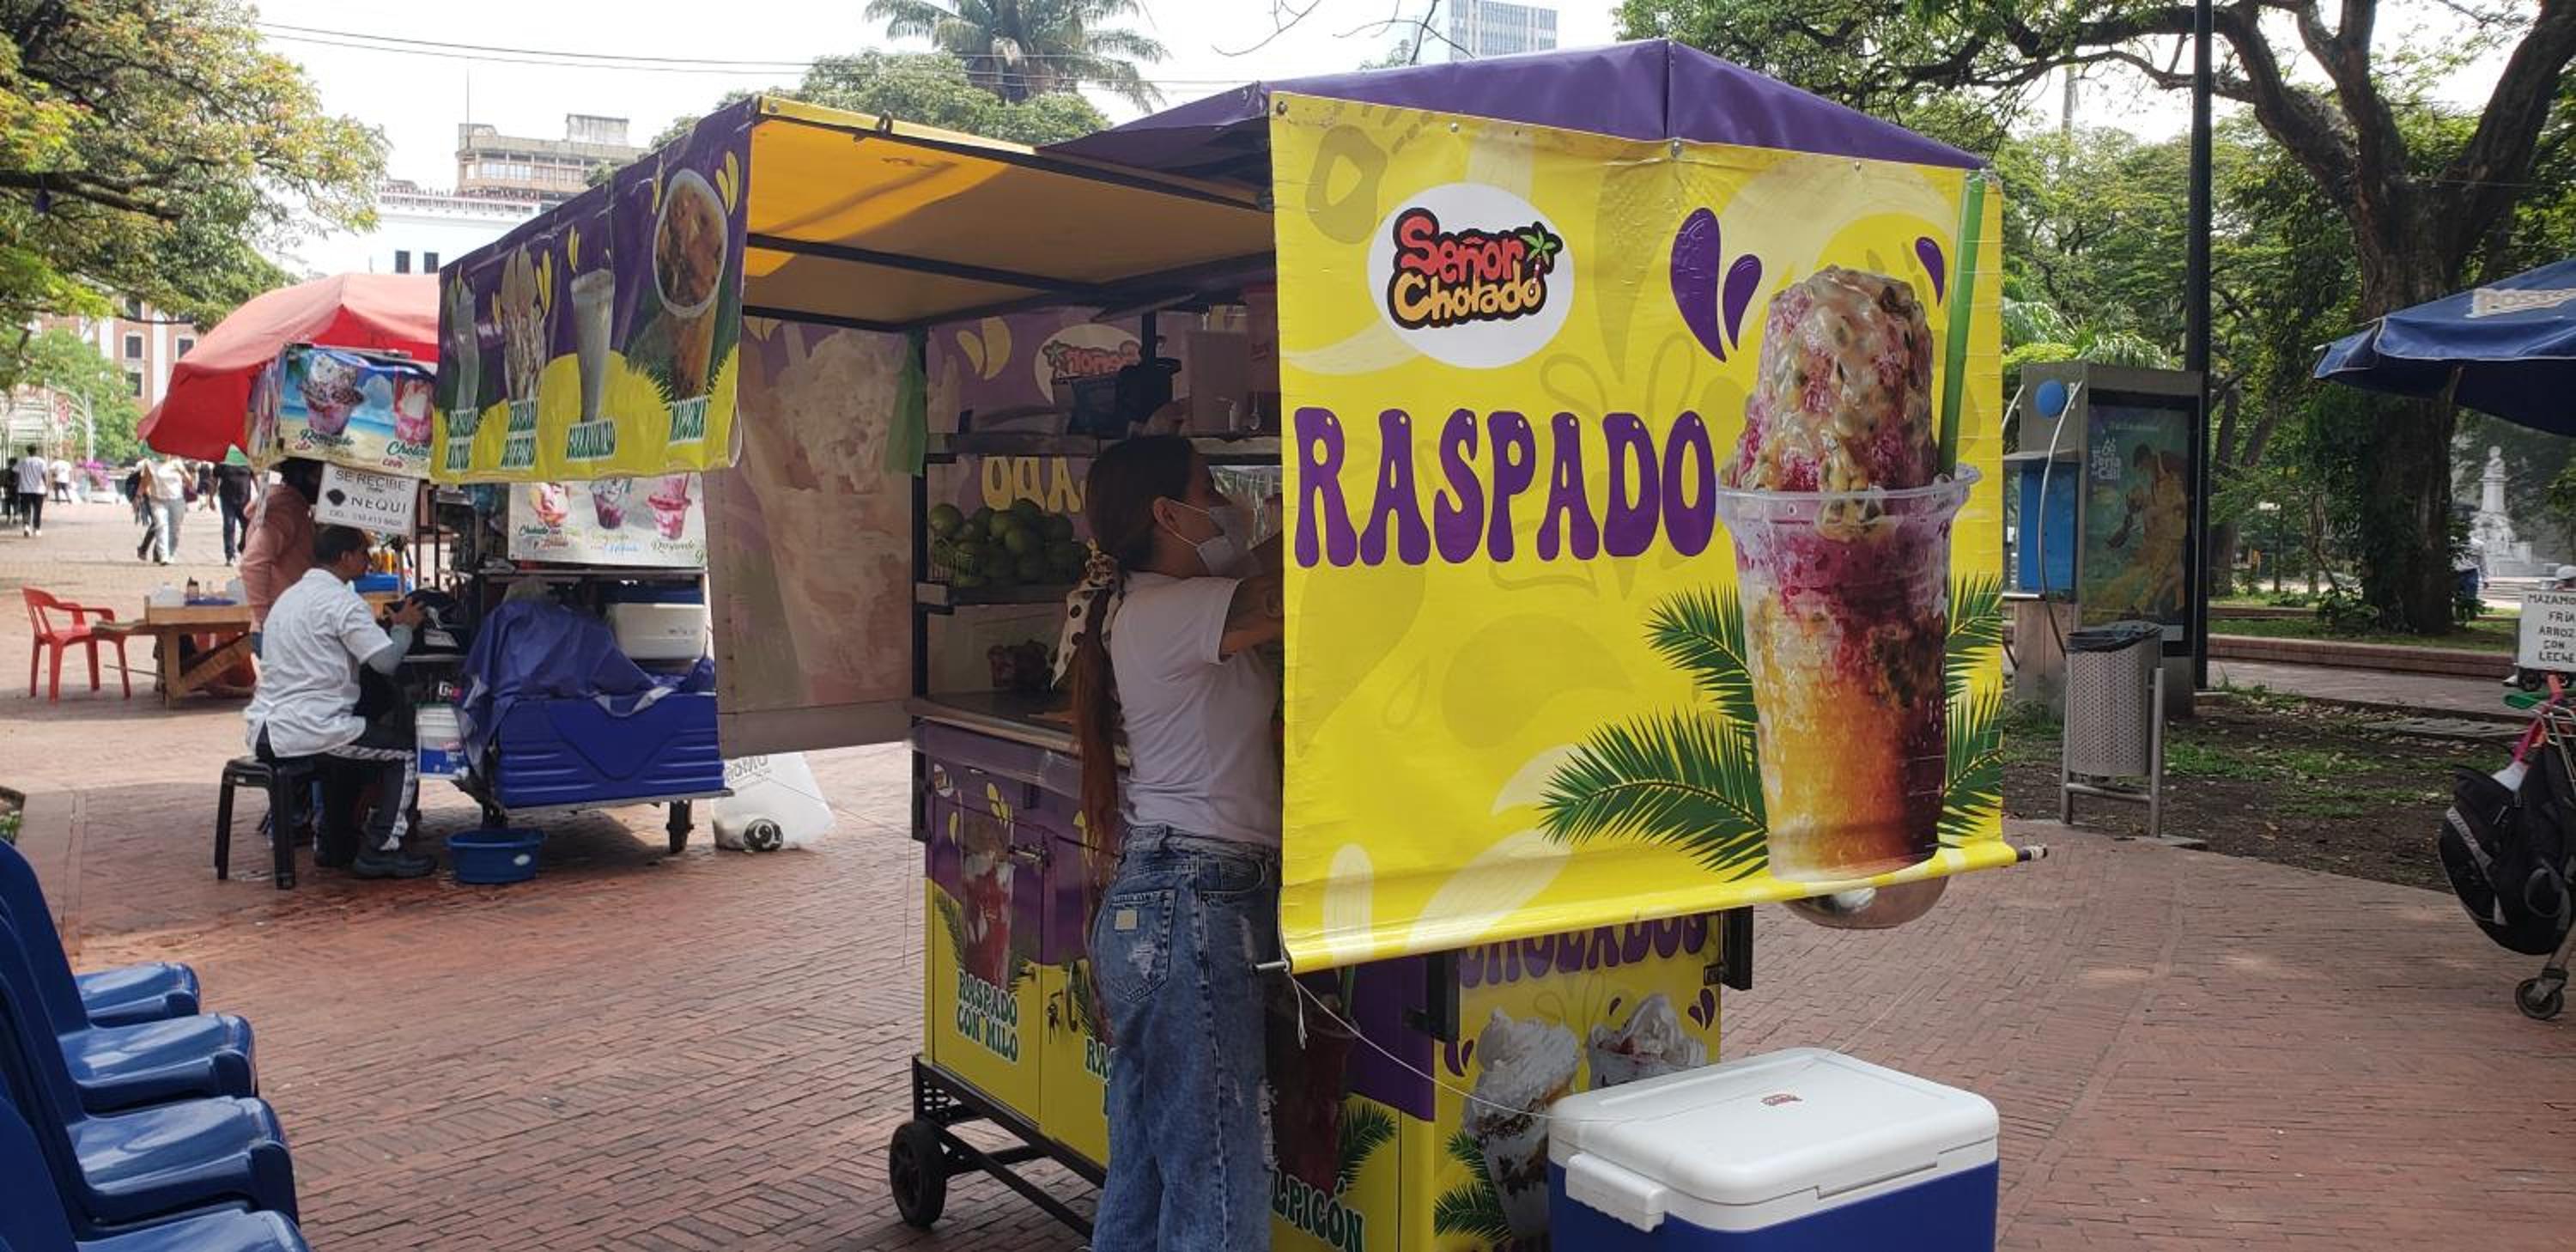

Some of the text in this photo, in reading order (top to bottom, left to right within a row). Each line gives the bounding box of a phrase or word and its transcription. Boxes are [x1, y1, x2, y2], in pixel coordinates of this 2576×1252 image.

[1398, 213, 1526, 284] Señor
[1392, 260, 1542, 323] Cholado
[334, 469, 353, 483] SE
[356, 472, 407, 492] RECIBE
[1293, 406, 1717, 568] RASPADO
[350, 495, 407, 514] NEQUI
[2527, 593, 2576, 605] MAZAMO
[2538, 625, 2575, 637] ARROZ
[2543, 640, 2565, 649] CON
[2538, 650, 2575, 664] LECHE
[957, 969, 1018, 1029] RASPADO
[957, 1003, 1018, 1062] CON MILO
[1270, 1166, 1365, 1252] LPICÓN
